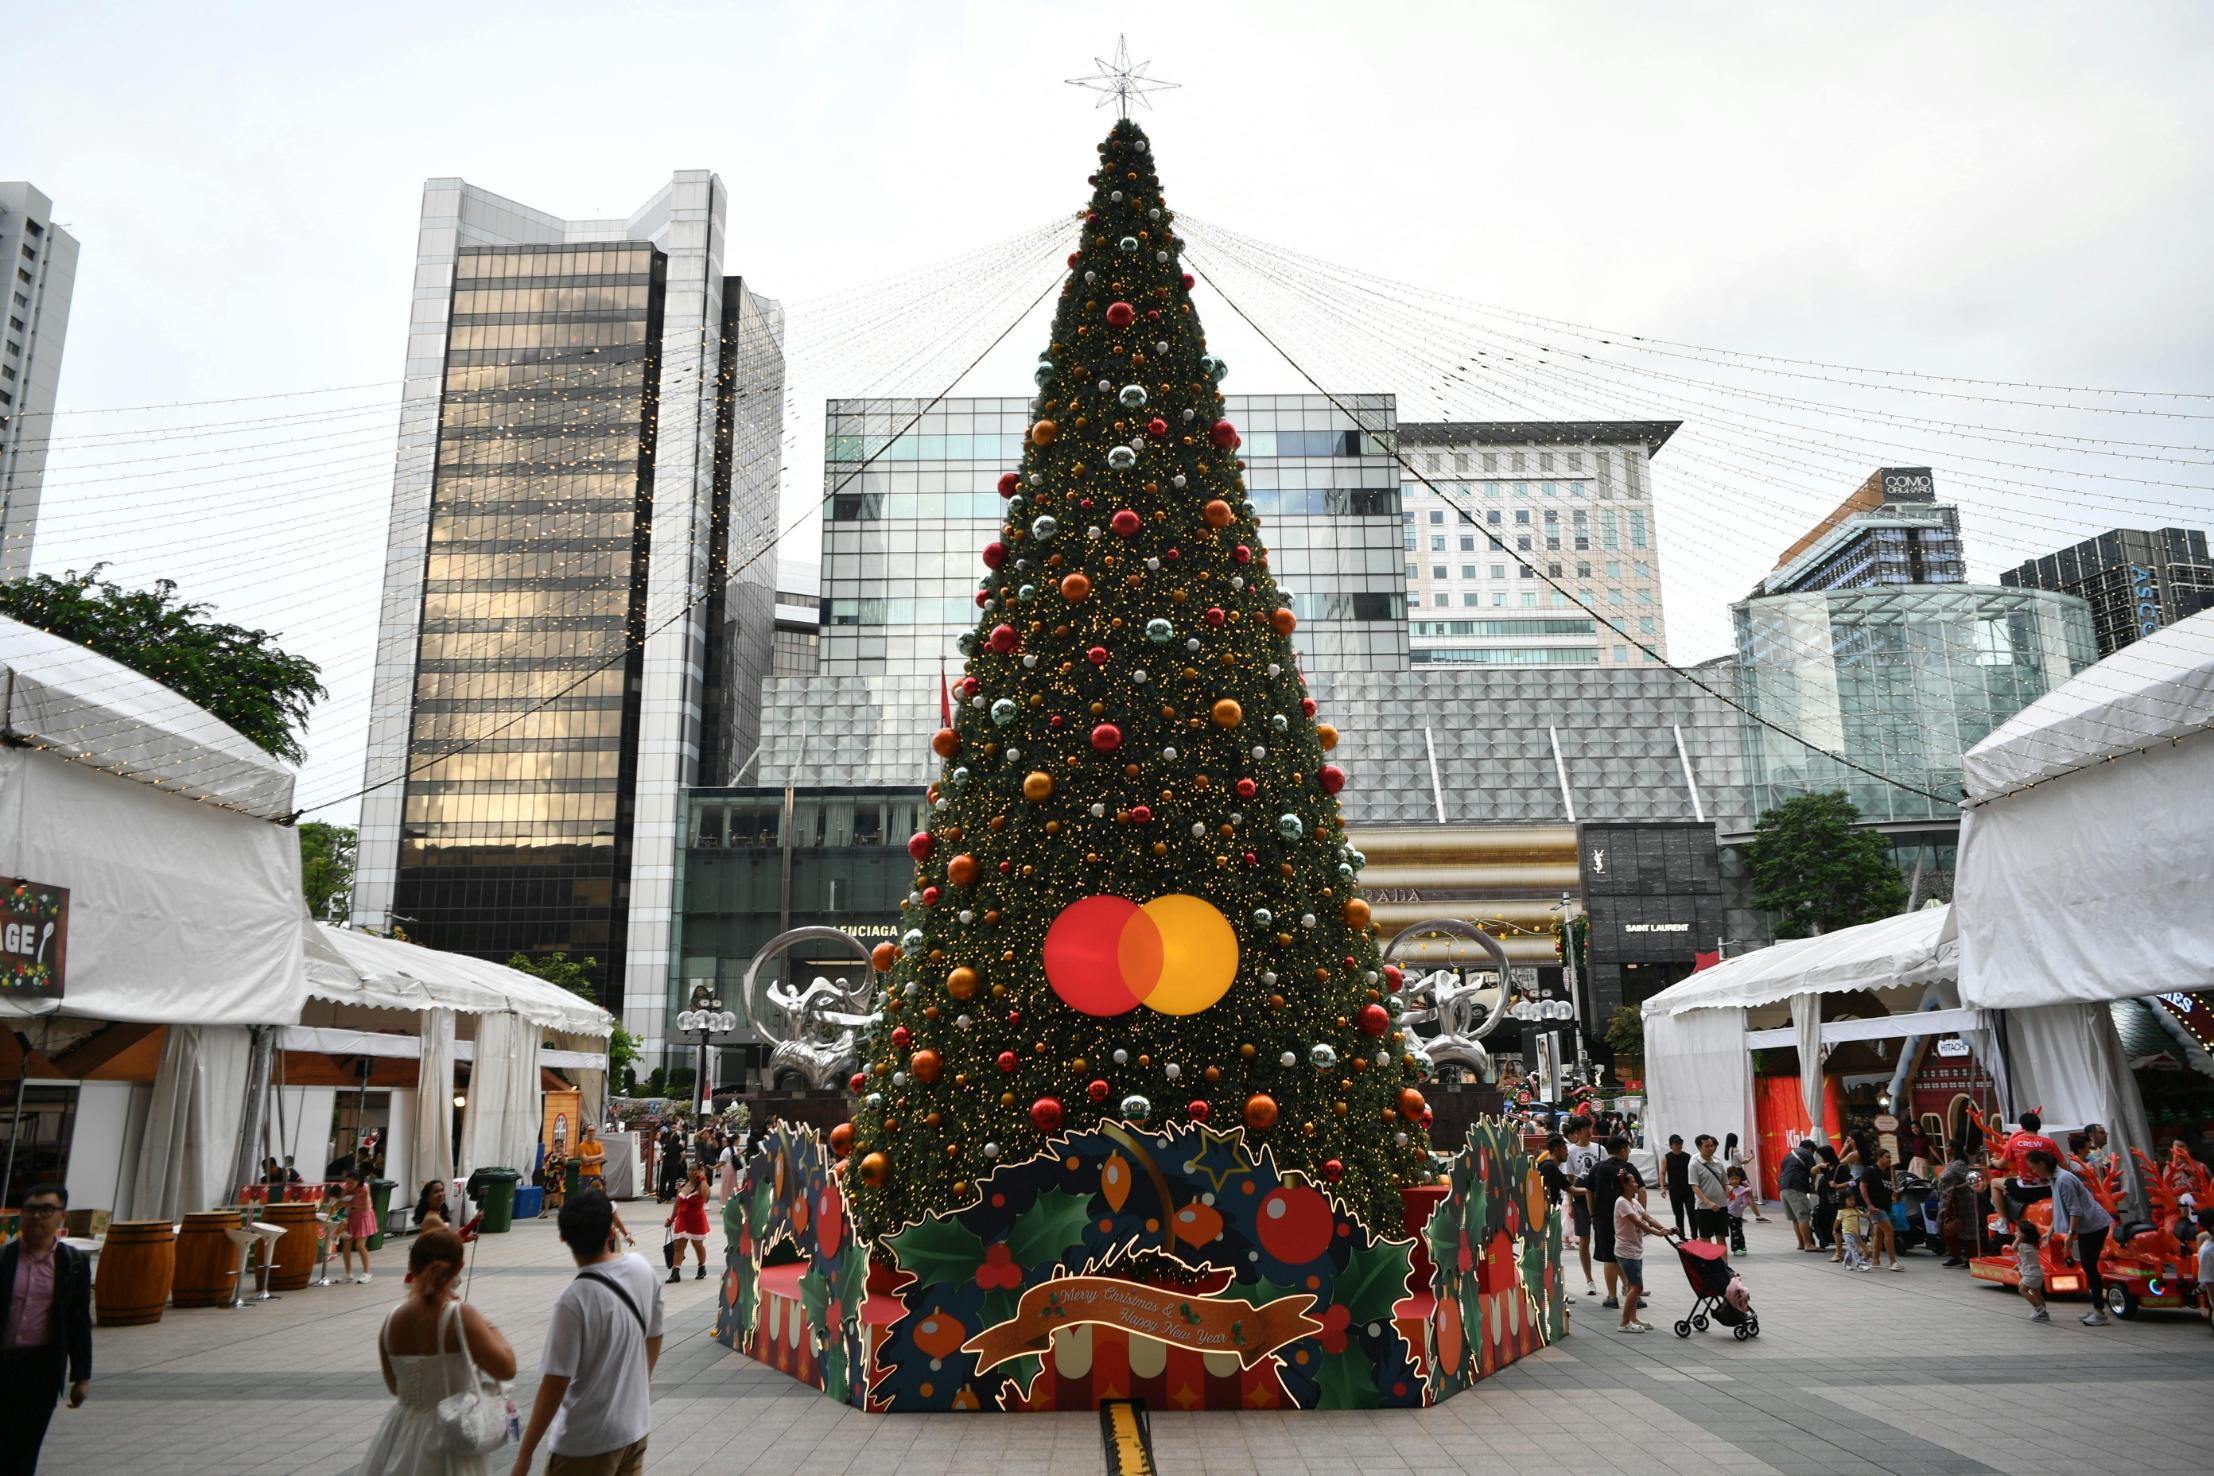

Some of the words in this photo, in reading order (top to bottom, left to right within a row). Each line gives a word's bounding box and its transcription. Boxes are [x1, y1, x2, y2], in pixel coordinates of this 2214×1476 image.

[1885, 475, 1931, 487] COMO
[833, 925, 899, 937] ENCIAGA
[1625, 923, 1649, 932] SAINT
[1650, 923, 1690, 932] LAURENT
[1060, 1287, 1098, 1304] Merry
[1104, 1286, 1158, 1312] Christmas
[1162, 1303, 1175, 1318] &
[1120, 1307, 1159, 1333] Happy
[1162, 1321, 1191, 1340] New
[1196, 1329, 1228, 1345] Year
